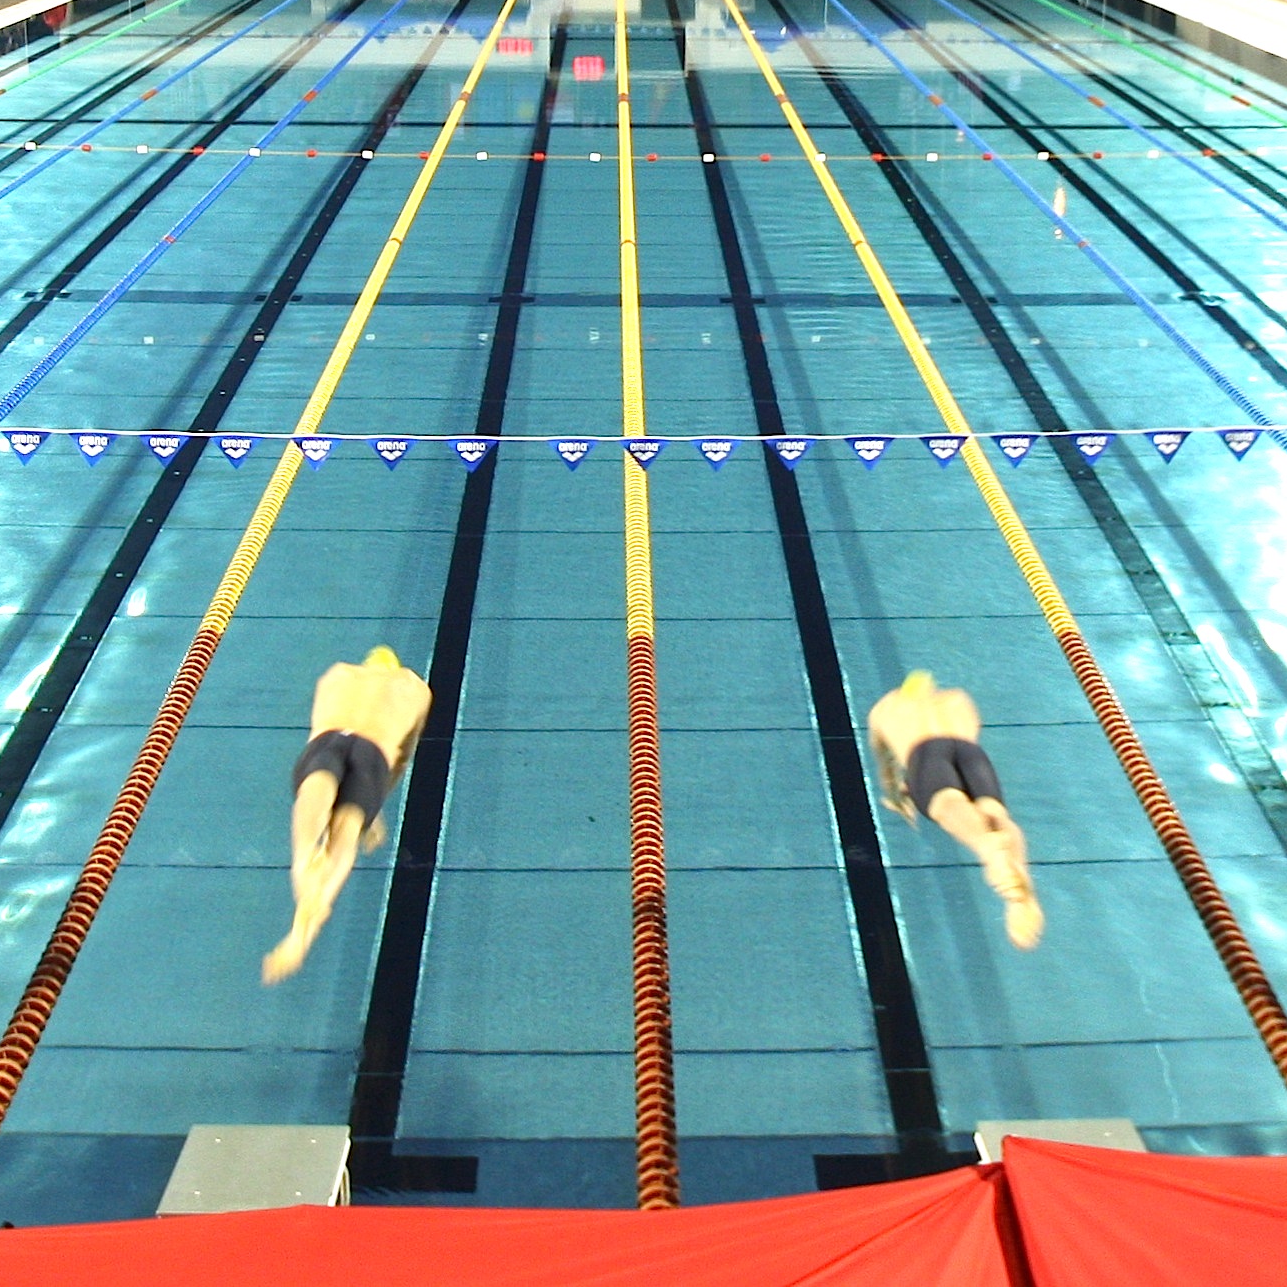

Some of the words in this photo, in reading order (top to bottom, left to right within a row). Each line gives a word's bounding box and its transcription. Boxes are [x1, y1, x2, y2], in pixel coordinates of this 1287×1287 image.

[11, 434, 40, 444] arena
[79, 436, 108, 446] arena
[149, 437, 179, 448] arena
[221, 438, 251, 449] arena
[302, 440, 332, 450] arena
[377, 440, 407, 450] arena
[457, 441, 486, 451] arena
[558, 441, 588, 451] arena
[629, 441, 659, 451] arena
[702, 441, 732, 451] arena
[776, 440, 806, 450] arena
